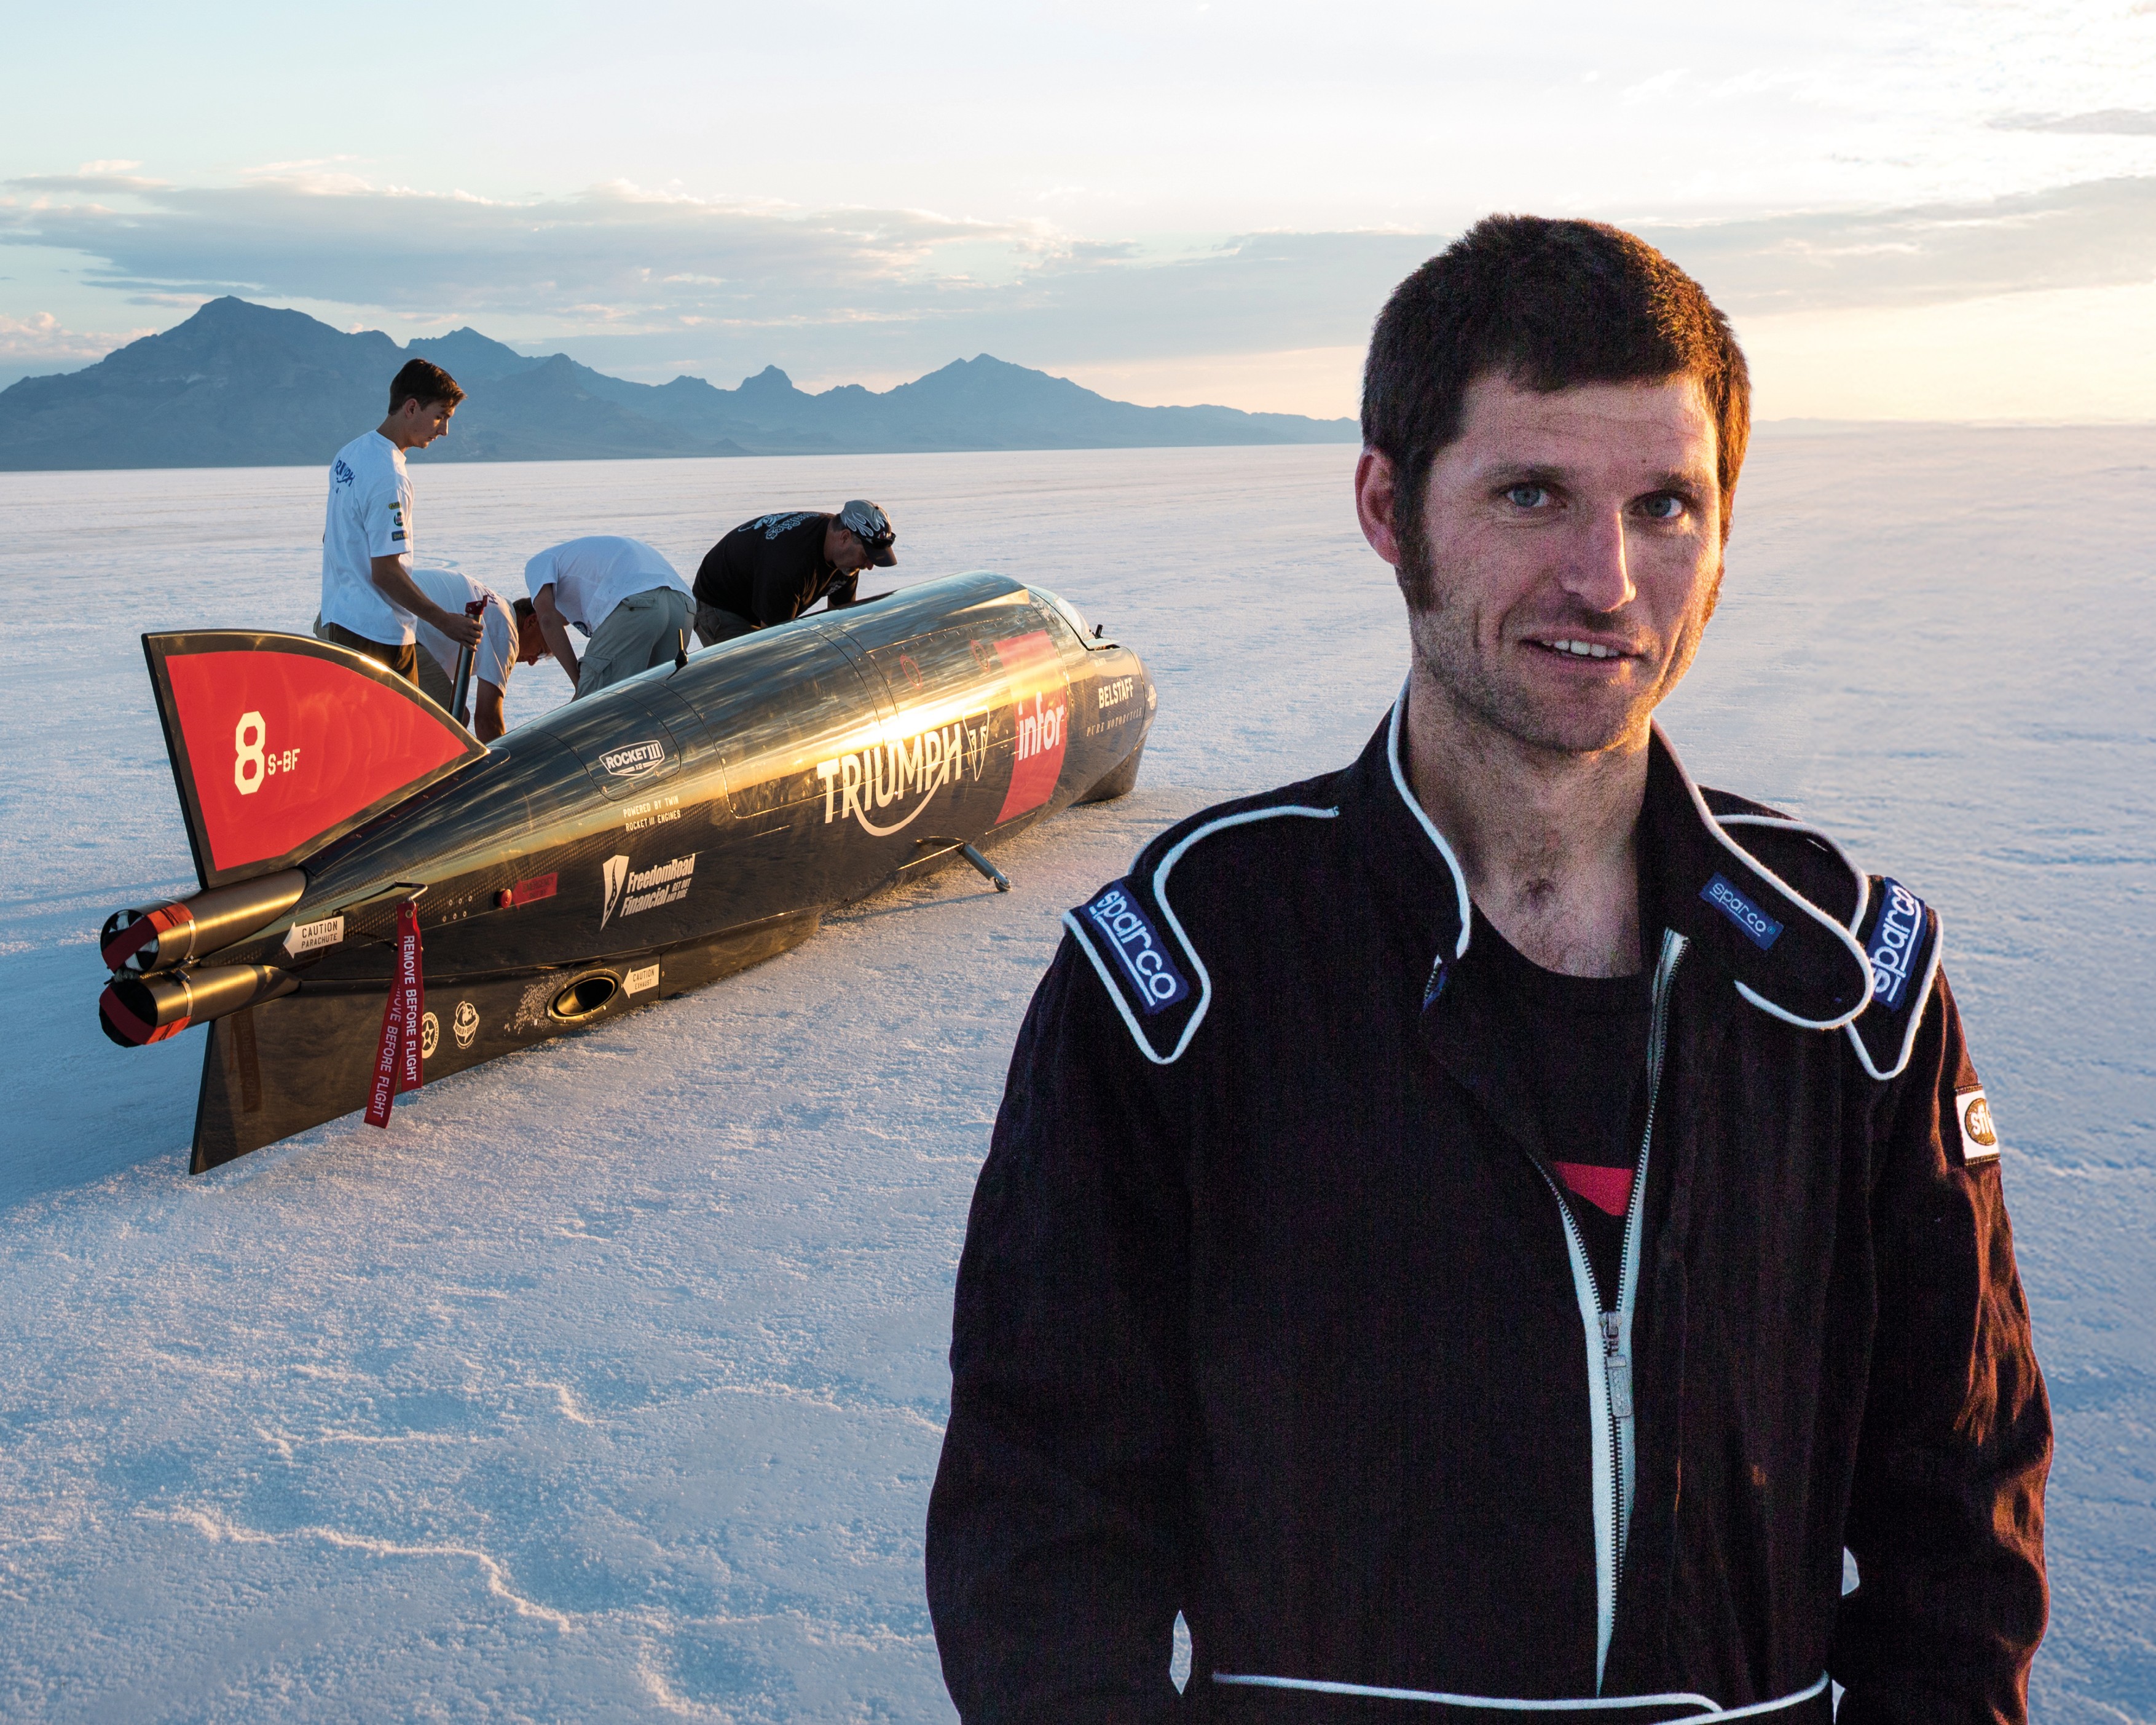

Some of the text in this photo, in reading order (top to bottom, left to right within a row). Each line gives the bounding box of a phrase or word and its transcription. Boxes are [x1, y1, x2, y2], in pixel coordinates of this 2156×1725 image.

[1098, 677, 1133, 709] BELSTAFF
[1018, 692, 1064, 761] infor
[1087, 722, 1104, 736] PURE
[1107, 708, 1142, 730] MOTORCYCLE
[235, 711, 301, 795] 8 S-BF
[605, 743, 661, 768] ROCKET III
[817, 724, 962, 837] TRIUMPH
[623, 795, 679, 818] POWERED BY TWIN
[626, 818, 647, 832] ROCKET
[658, 809, 681, 824] ENGINES
[627, 853, 695, 894] FreedomRoad
[672, 878, 691, 892] GET OUT
[620, 885, 670, 917] Financial
[1712, 883, 1766, 933] sparco
[301, 933, 337, 949] PARACHUTE
[302, 920, 337, 939] CAUTION
[1093, 891, 1176, 1000] sparco
[633, 968, 655, 982] CAUTION
[635, 979, 651, 990] EXHAUST
[404, 935, 417, 1081] REMOVE BEFORE FLIGHT
[380, 1024, 398, 1073] BEFORE
[372, 1075, 390, 1118] FLIGHT
